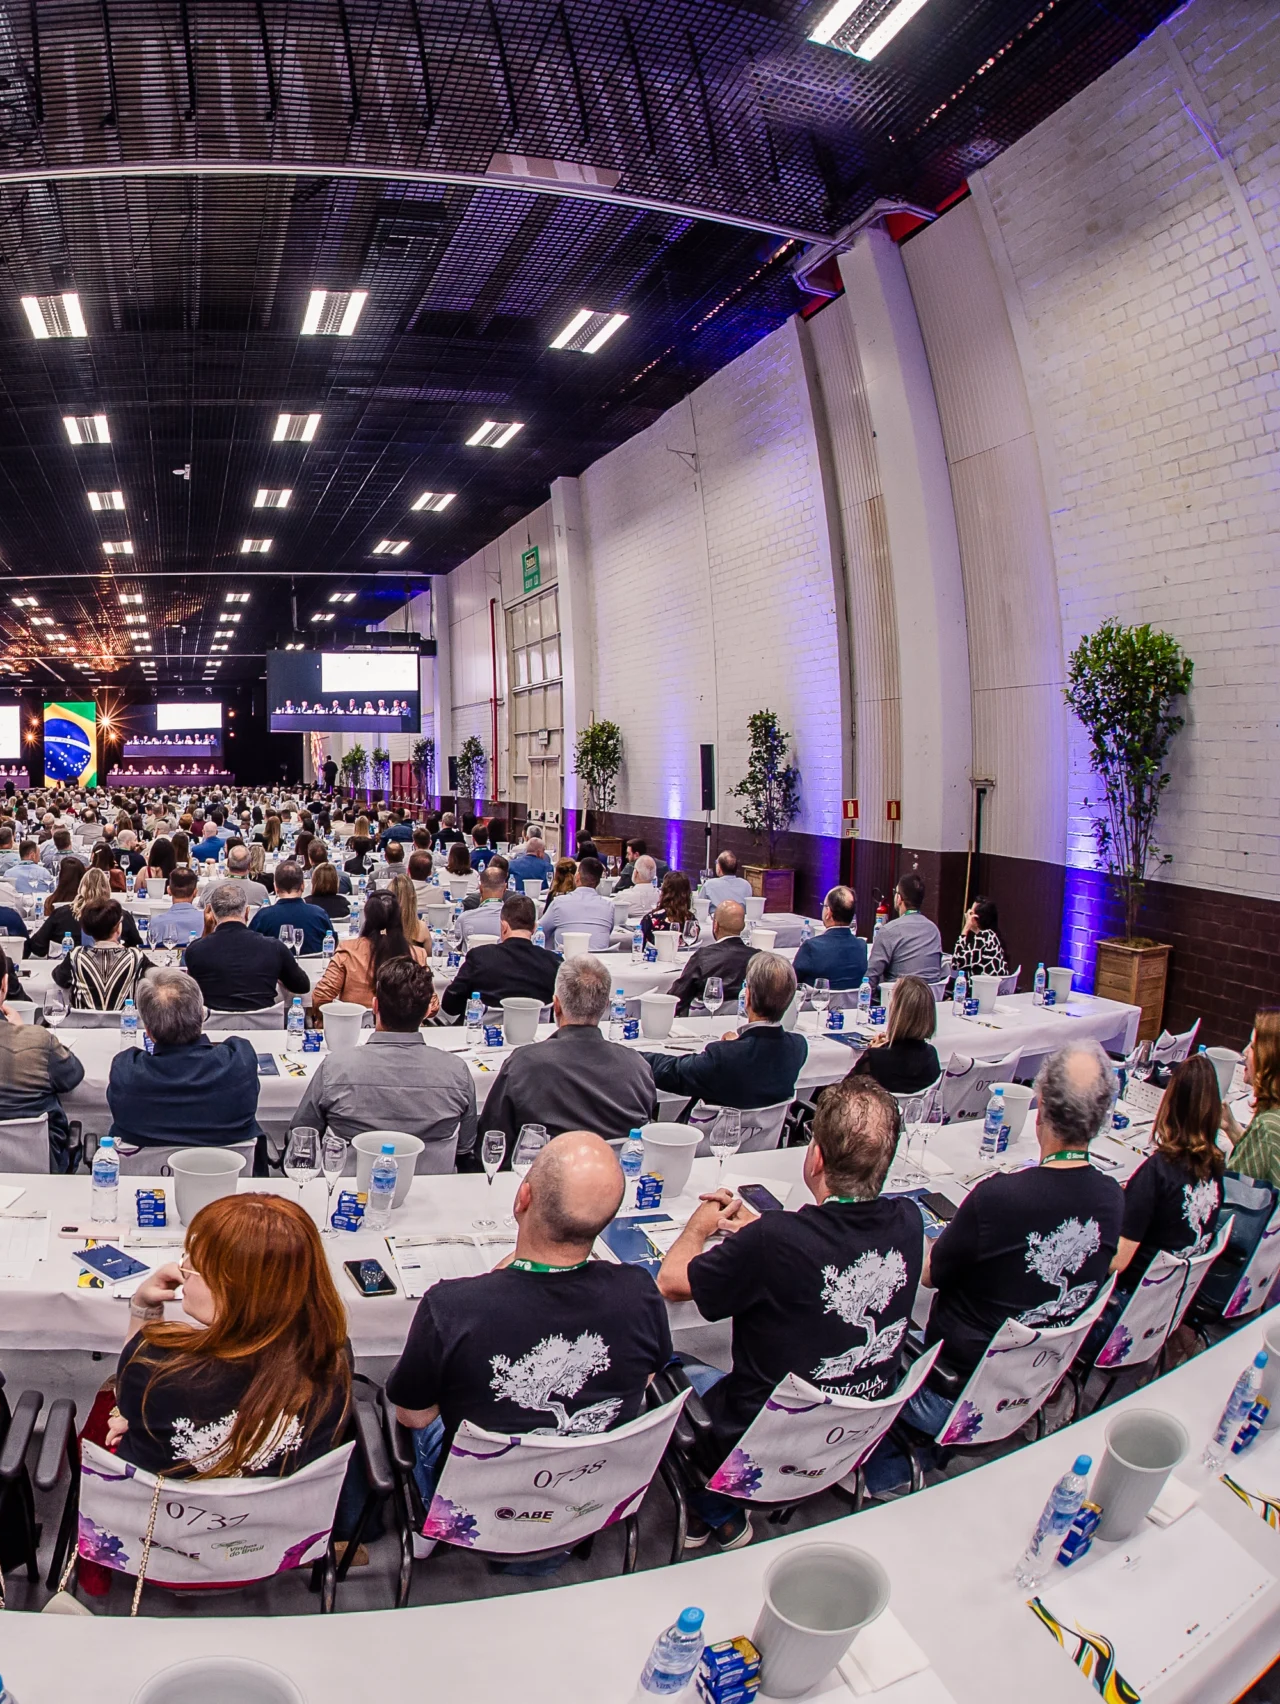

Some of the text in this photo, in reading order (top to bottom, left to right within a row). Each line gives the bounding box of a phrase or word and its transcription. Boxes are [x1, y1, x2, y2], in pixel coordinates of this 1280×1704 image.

[819, 1374, 883, 1397] VINÍCOLA
[533, 1459, 608, 1489] 0738
[794, 1466, 827, 1477] ABE
[165, 1501, 250, 1531] 0737
[514, 1510, 555, 1520] ABE
[229, 1543, 258, 1552] Vinhos
[229, 1544, 265, 1558] do Brasil
